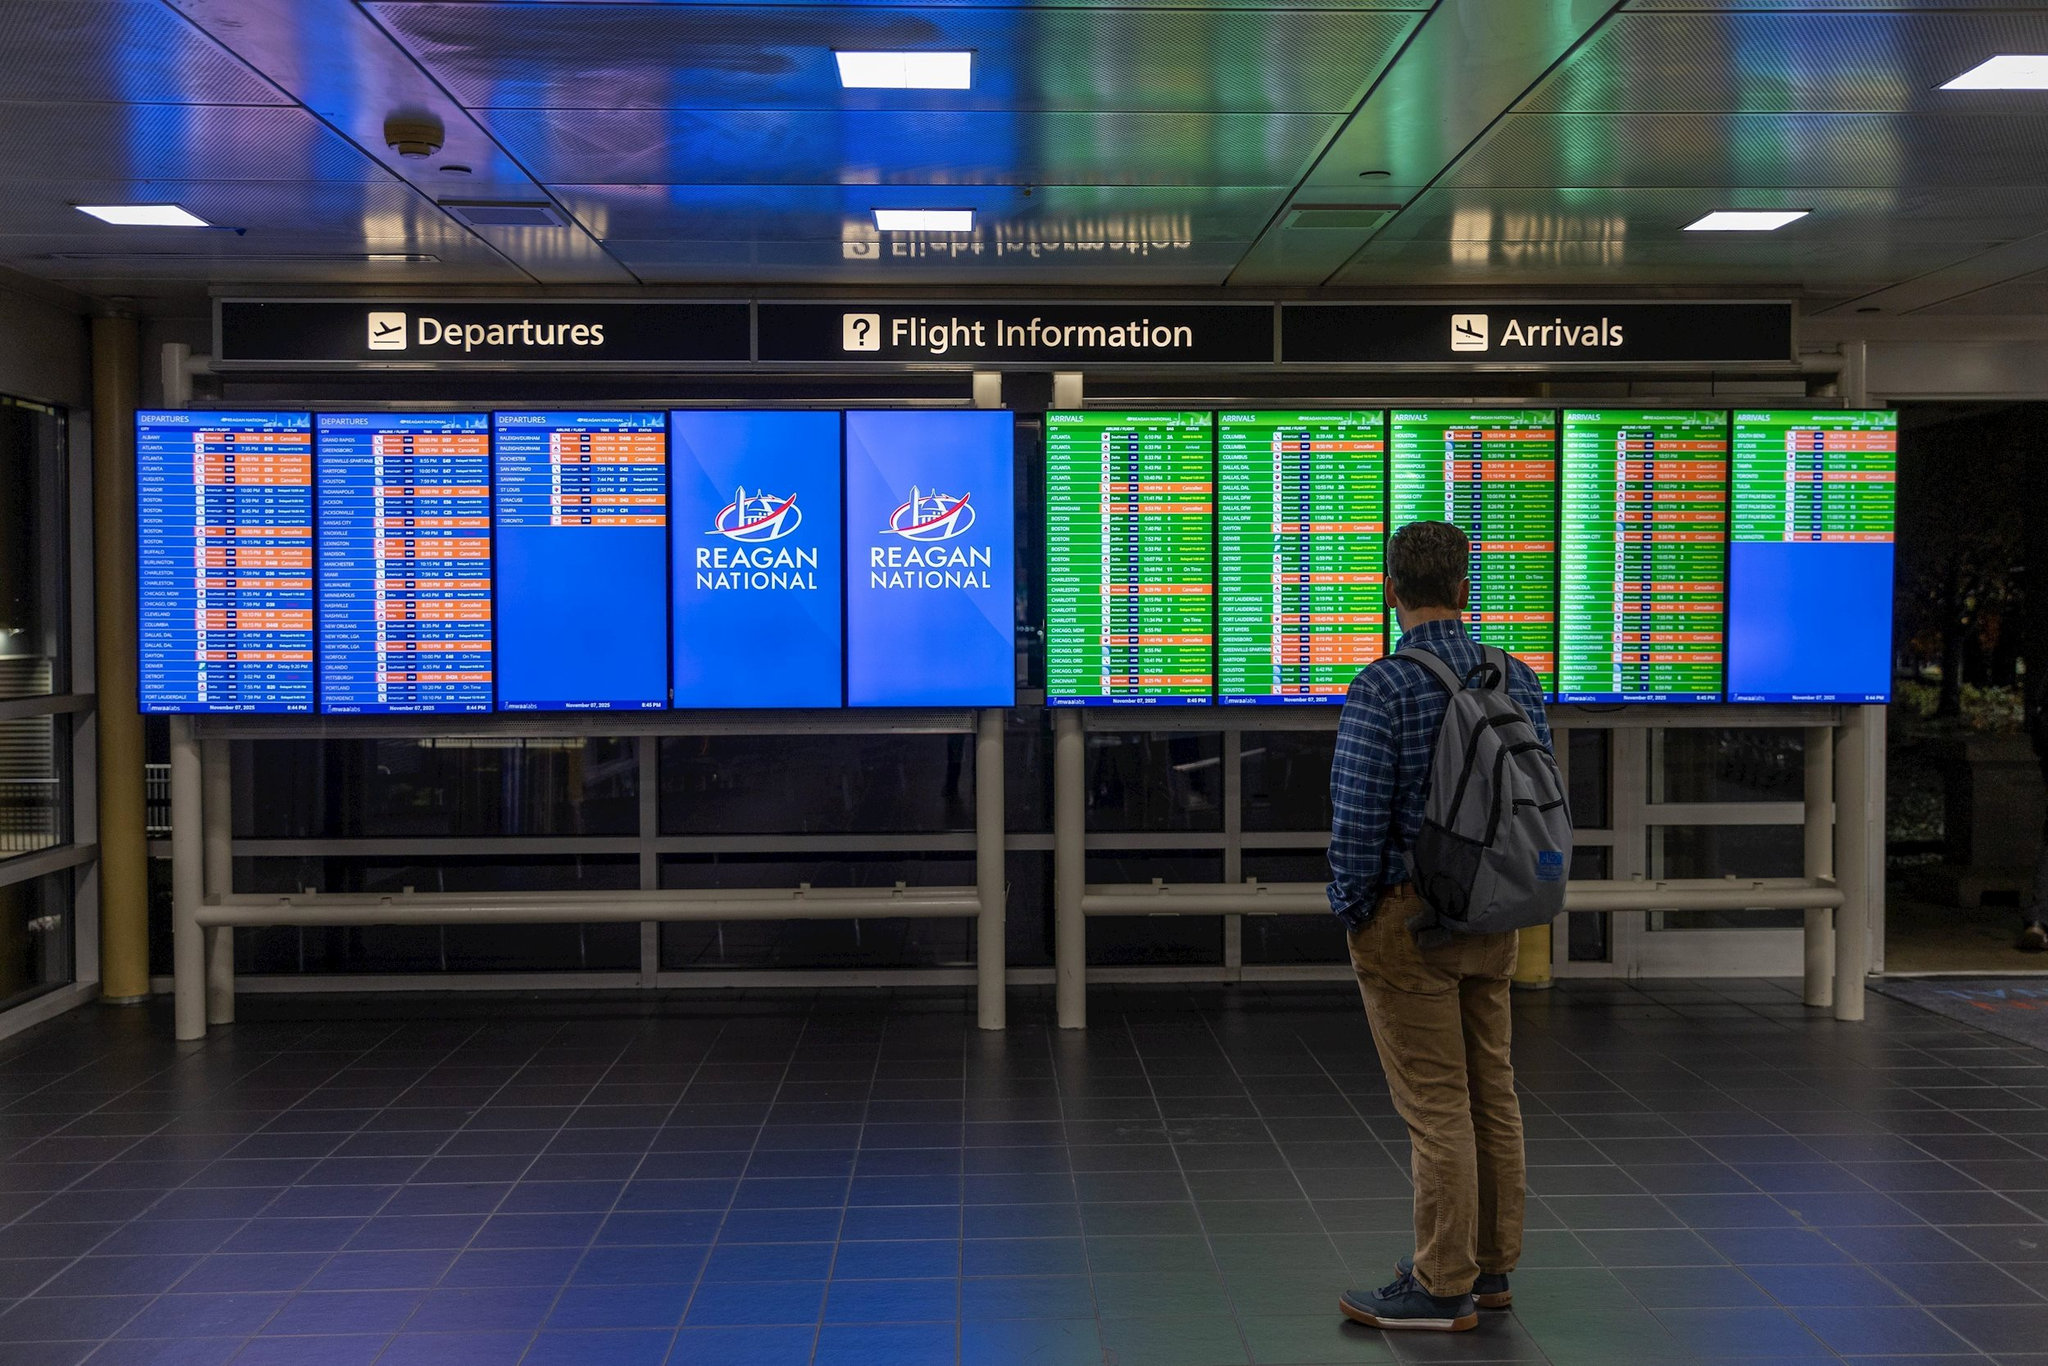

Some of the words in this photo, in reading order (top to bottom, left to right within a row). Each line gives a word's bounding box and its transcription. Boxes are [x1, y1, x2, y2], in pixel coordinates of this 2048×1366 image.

[418, 318, 605, 352] Departures
[892, 317, 986, 355] Flight
[997, 317, 1193, 350] Information
[1500, 317, 1624, 347] Arrivals
[696, 547, 817, 569] REAGAN
[870, 546, 991, 568] REAGAN
[696, 571, 817, 590] NATIONAL
[871, 570, 991, 589] NATIONAL
